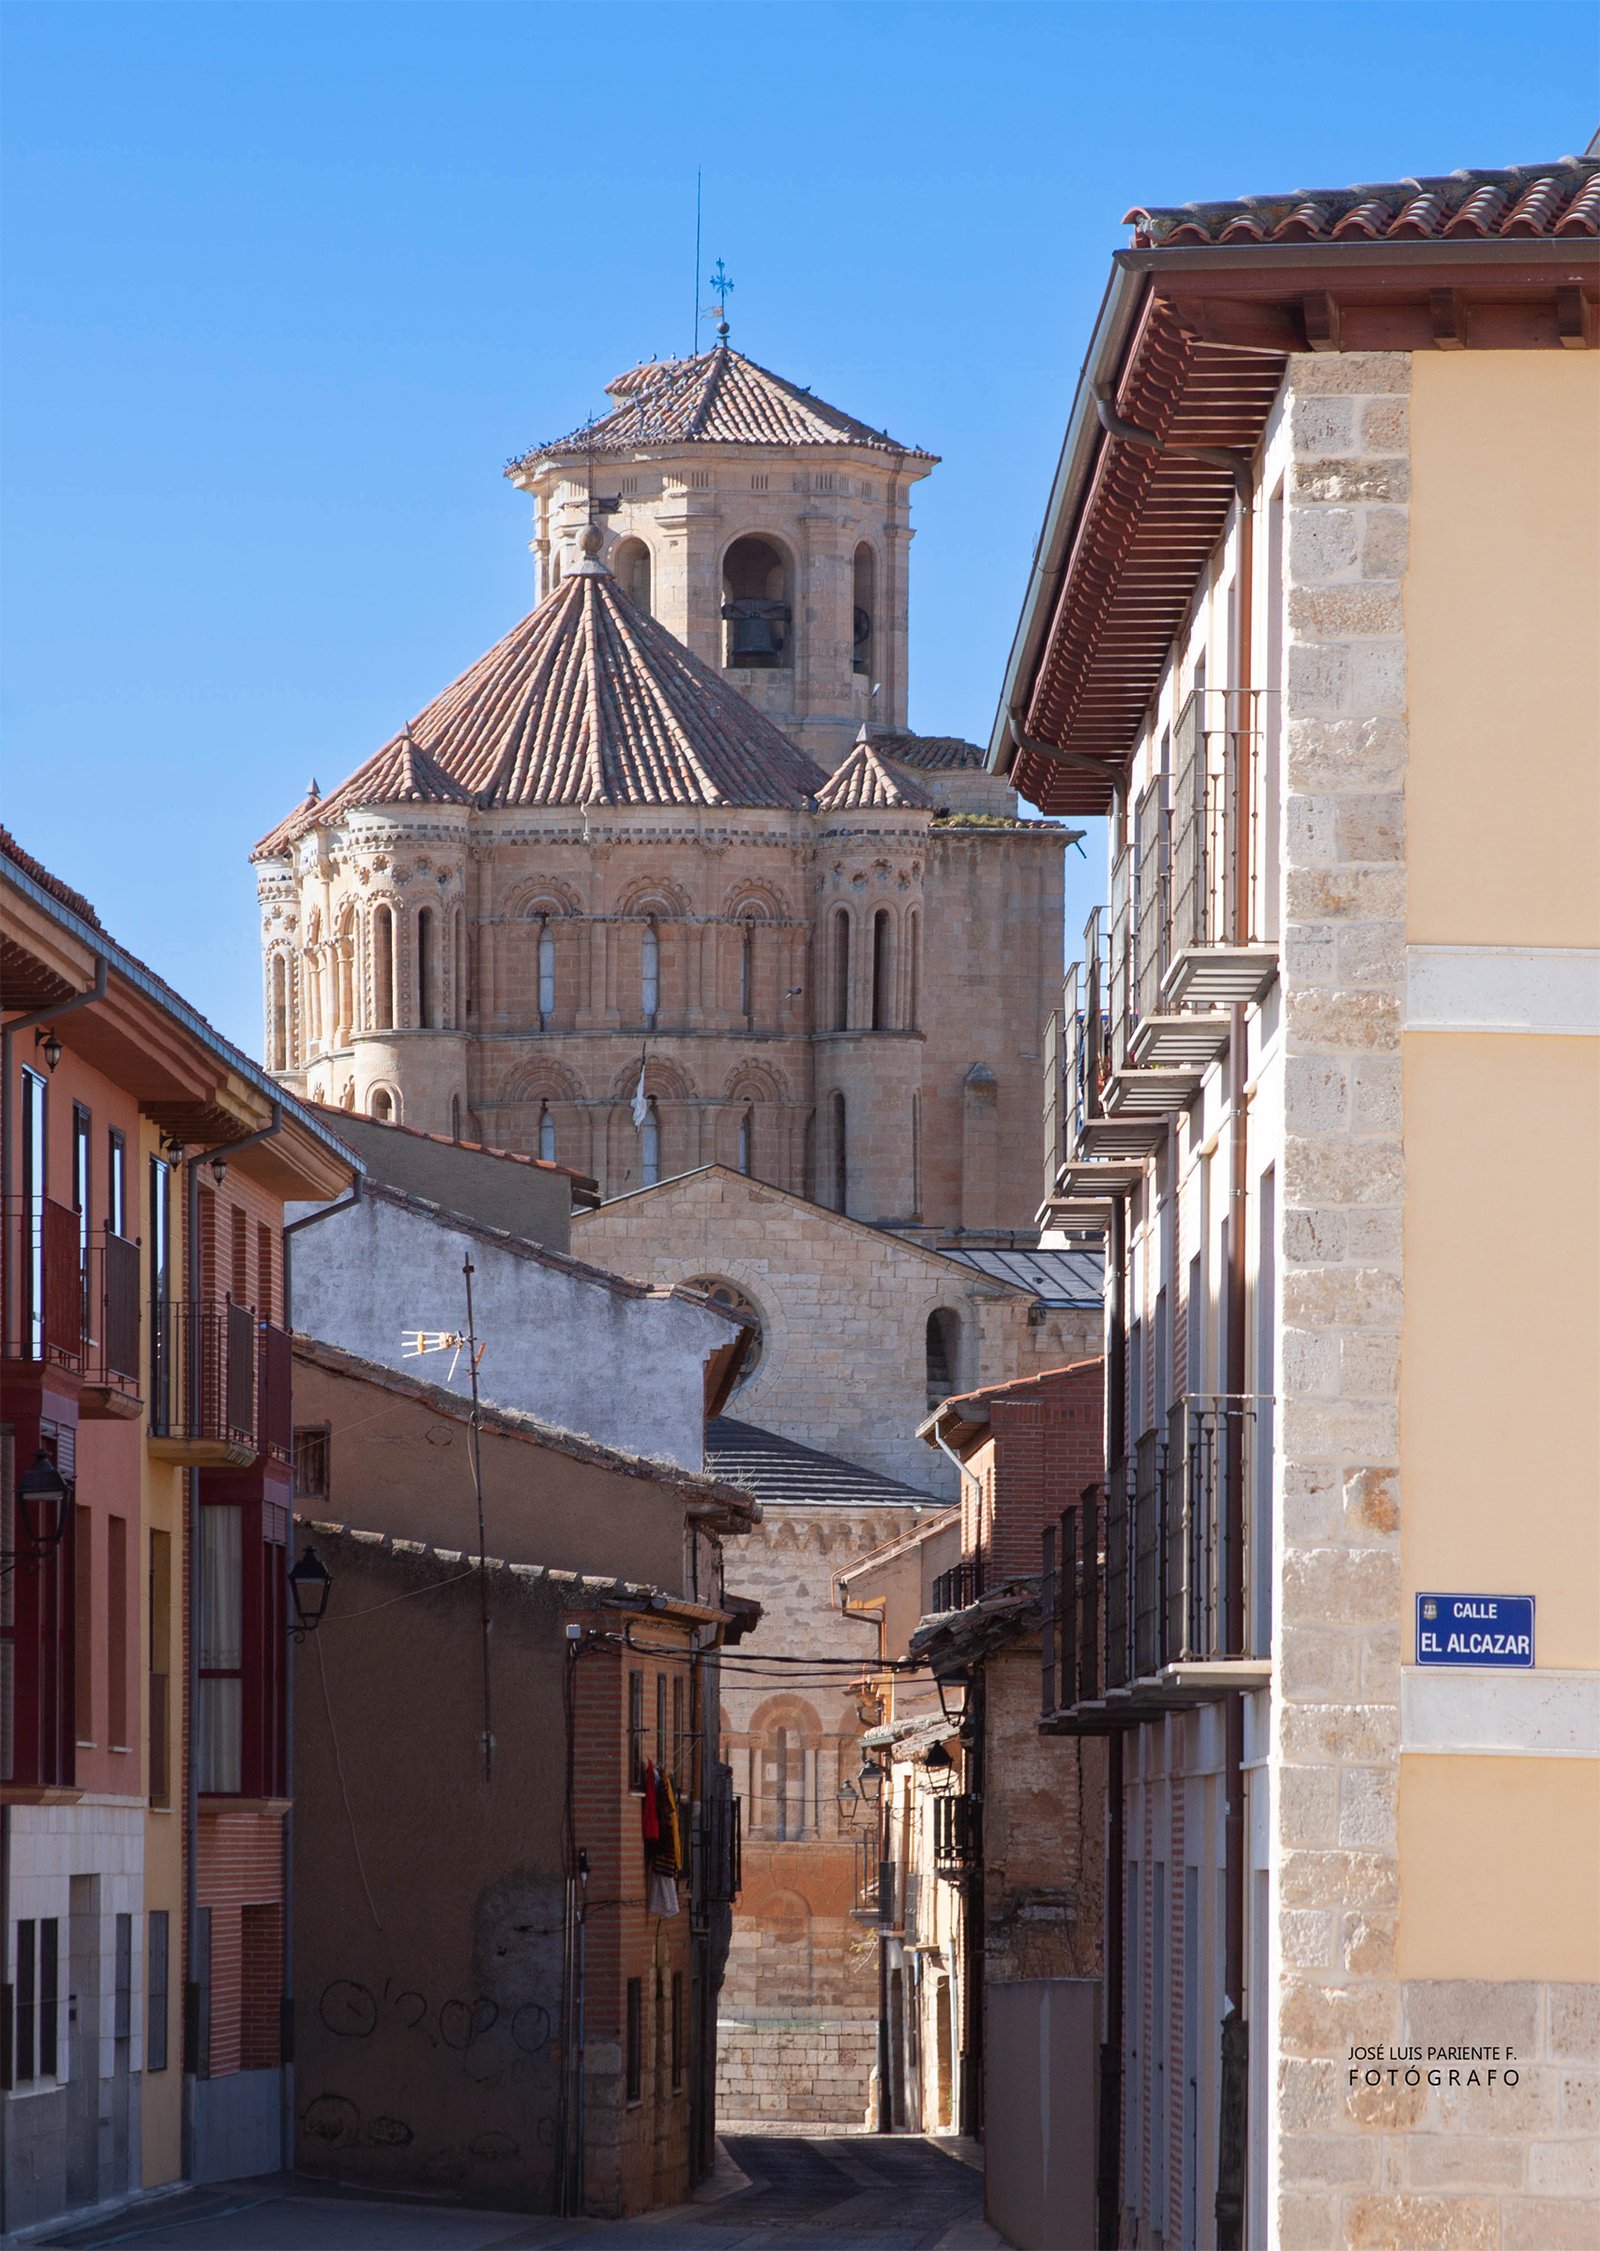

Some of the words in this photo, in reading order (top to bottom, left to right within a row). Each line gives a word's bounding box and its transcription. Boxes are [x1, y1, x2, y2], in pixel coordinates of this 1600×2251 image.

[1453, 1602, 1498, 1619] CALLE
[1421, 1632, 1442, 1652] EL
[1447, 1633, 1530, 1655] ALCAZAR
